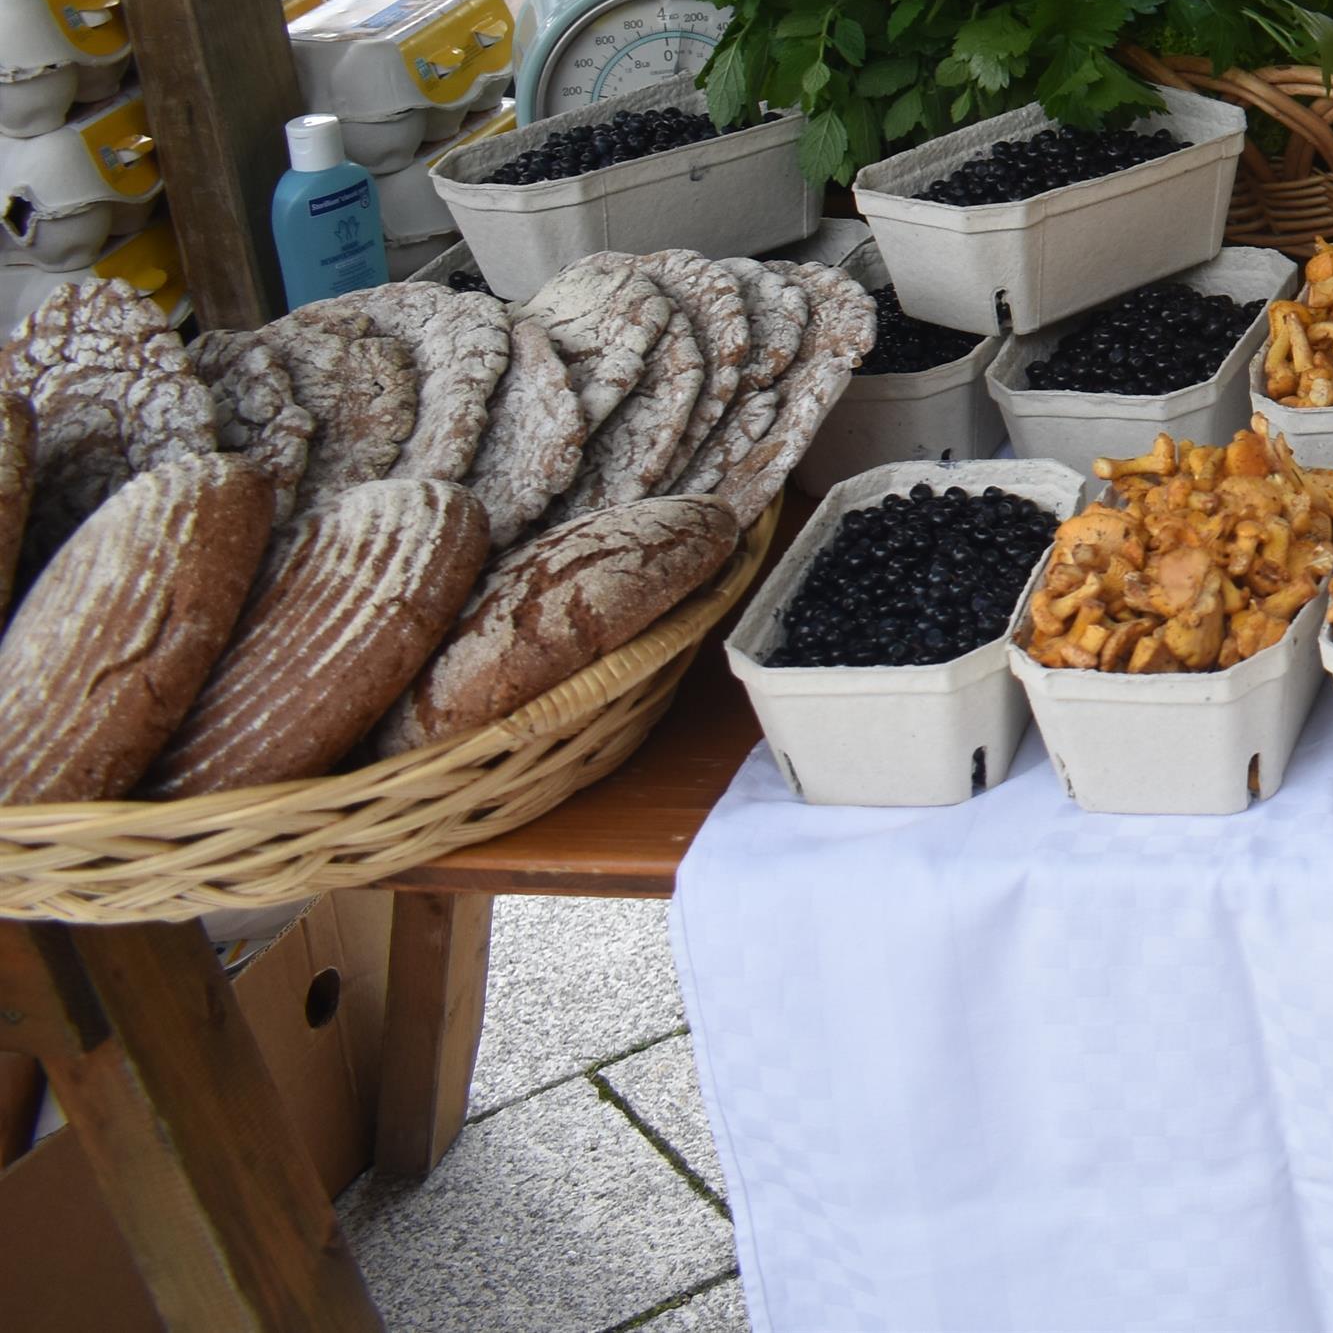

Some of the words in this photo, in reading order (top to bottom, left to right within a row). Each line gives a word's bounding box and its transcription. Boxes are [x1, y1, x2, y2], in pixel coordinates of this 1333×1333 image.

[624, 19, 643, 30] 800
[595, 35, 615, 46] 600
[664, 50, 673, 62] 0
[574, 58, 594, 68] 400
[562, 86, 582, 96] 200
